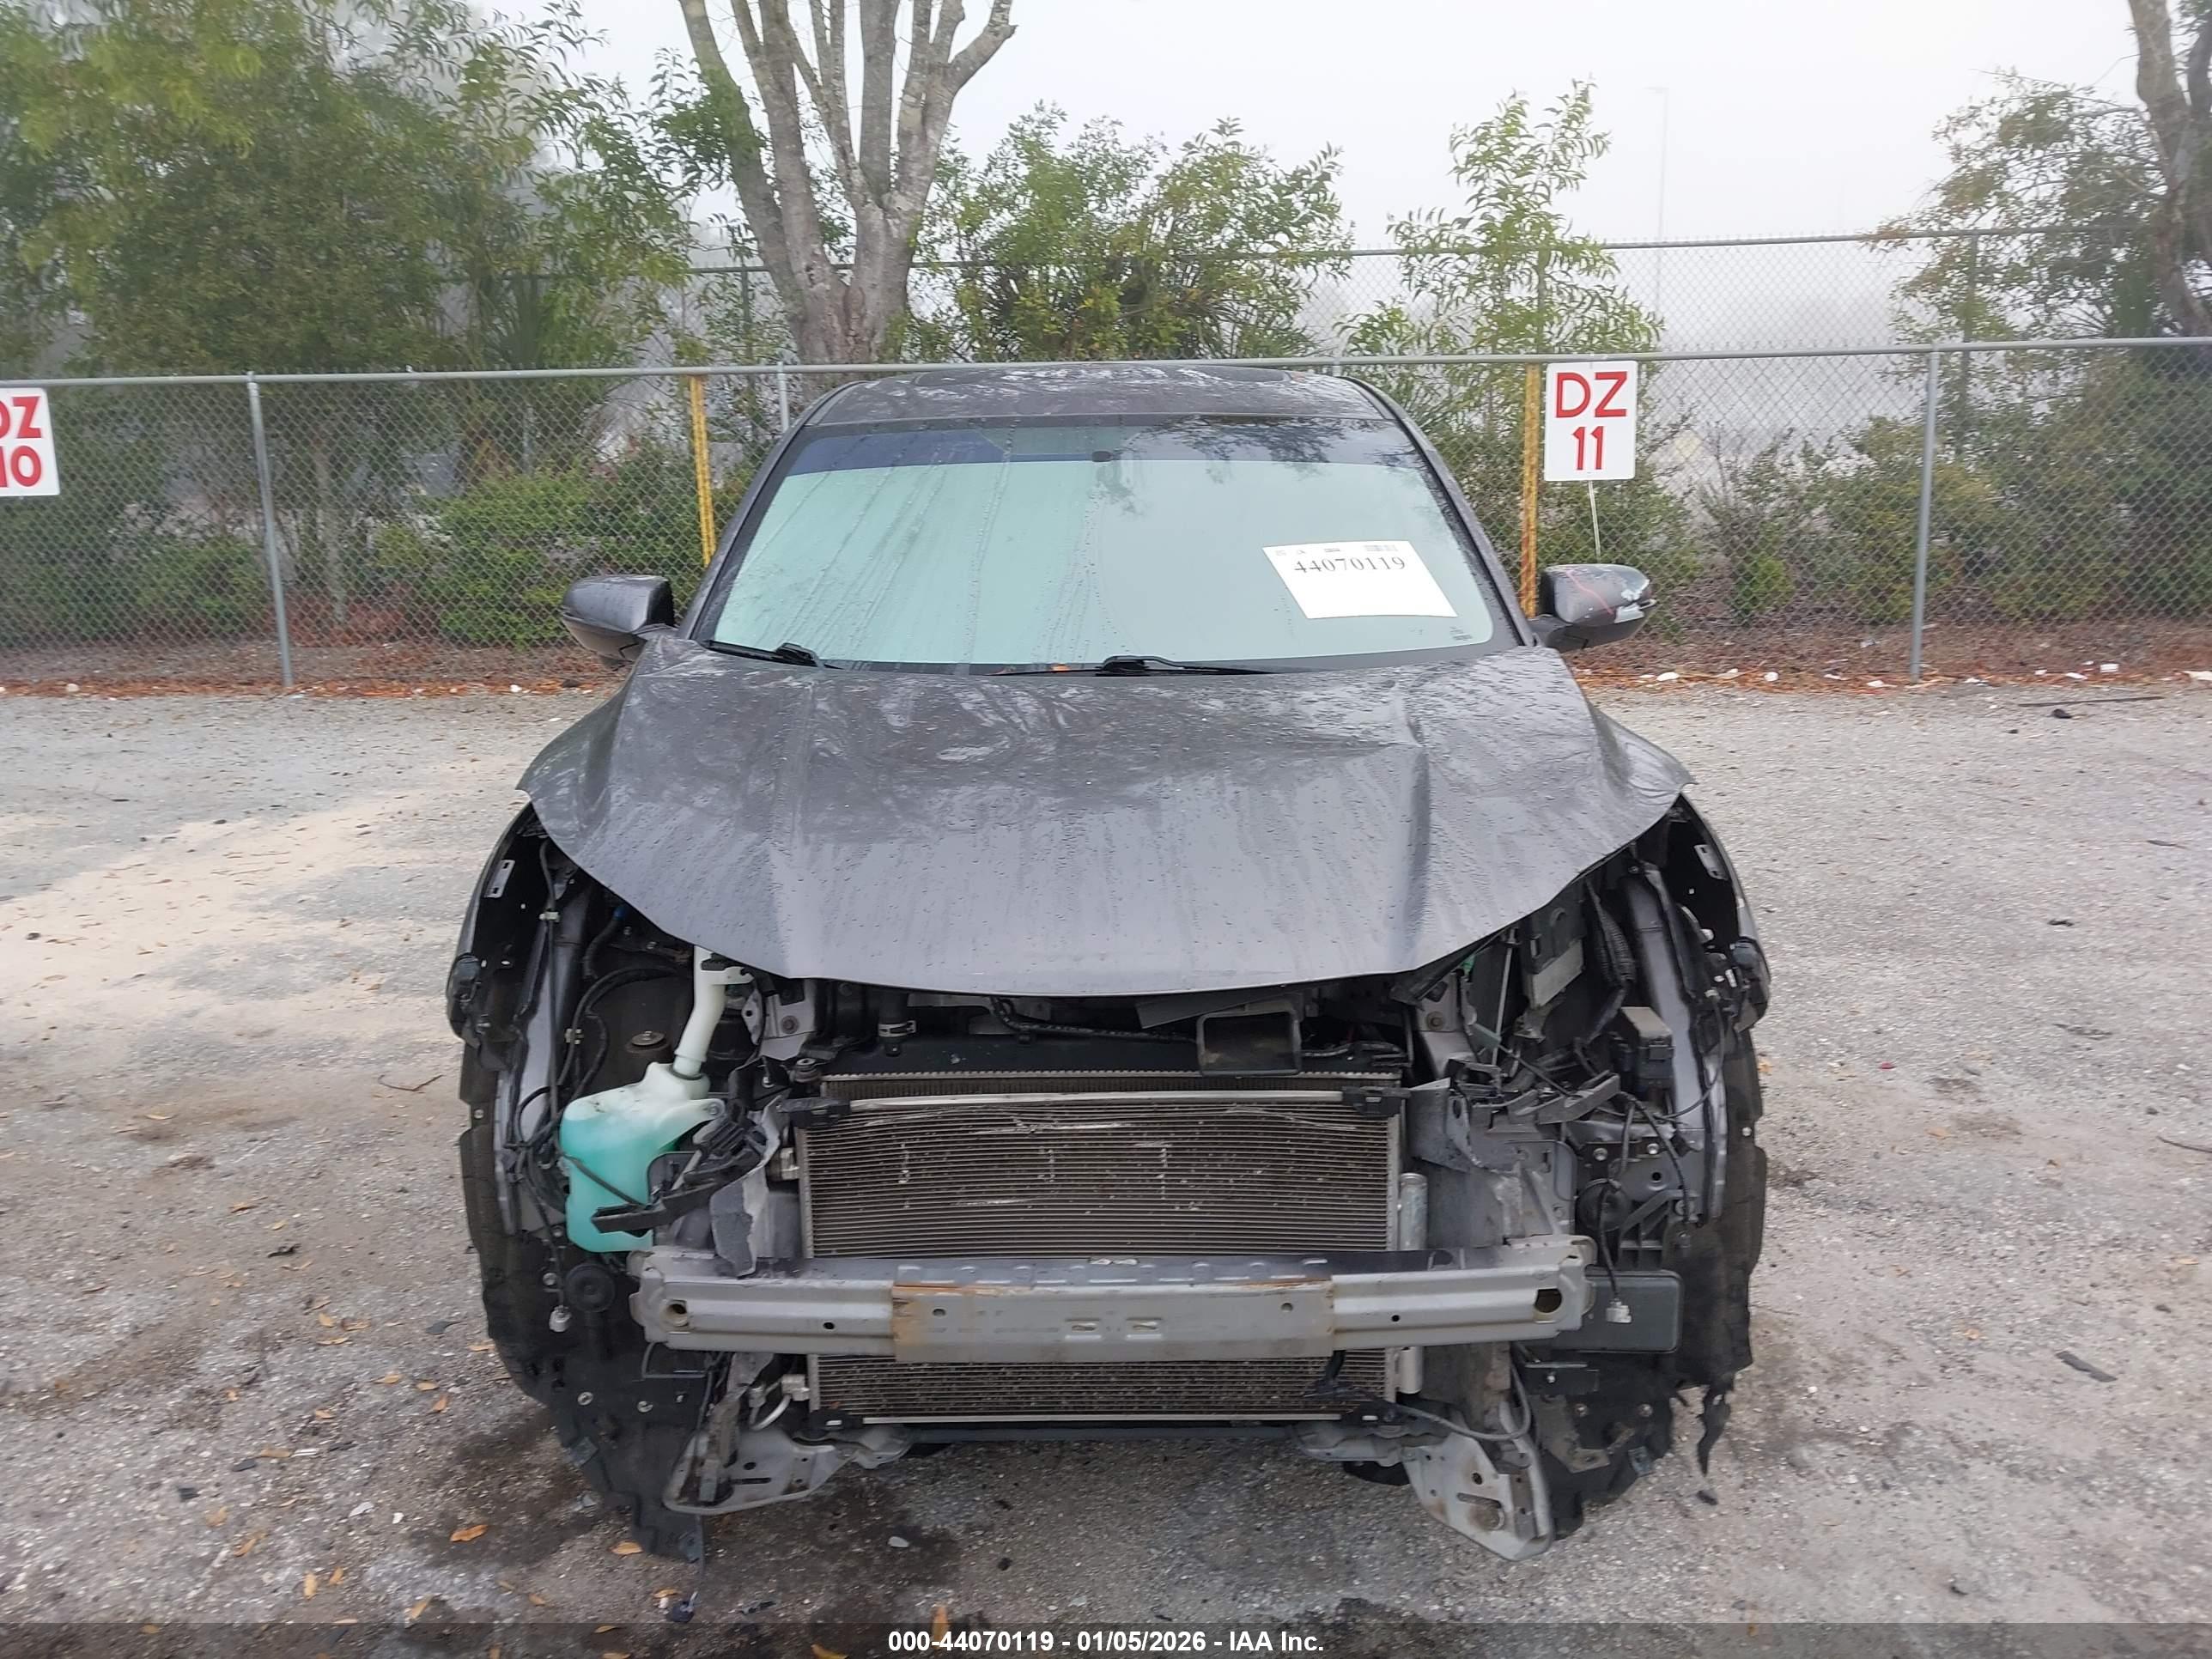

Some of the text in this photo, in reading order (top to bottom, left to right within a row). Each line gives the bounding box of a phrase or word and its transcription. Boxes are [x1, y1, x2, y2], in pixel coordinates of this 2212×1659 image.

[1555, 371, 1627, 418] DZ
[1572, 425, 1604, 470] 11
[1294, 556, 1406, 574] 44070119
